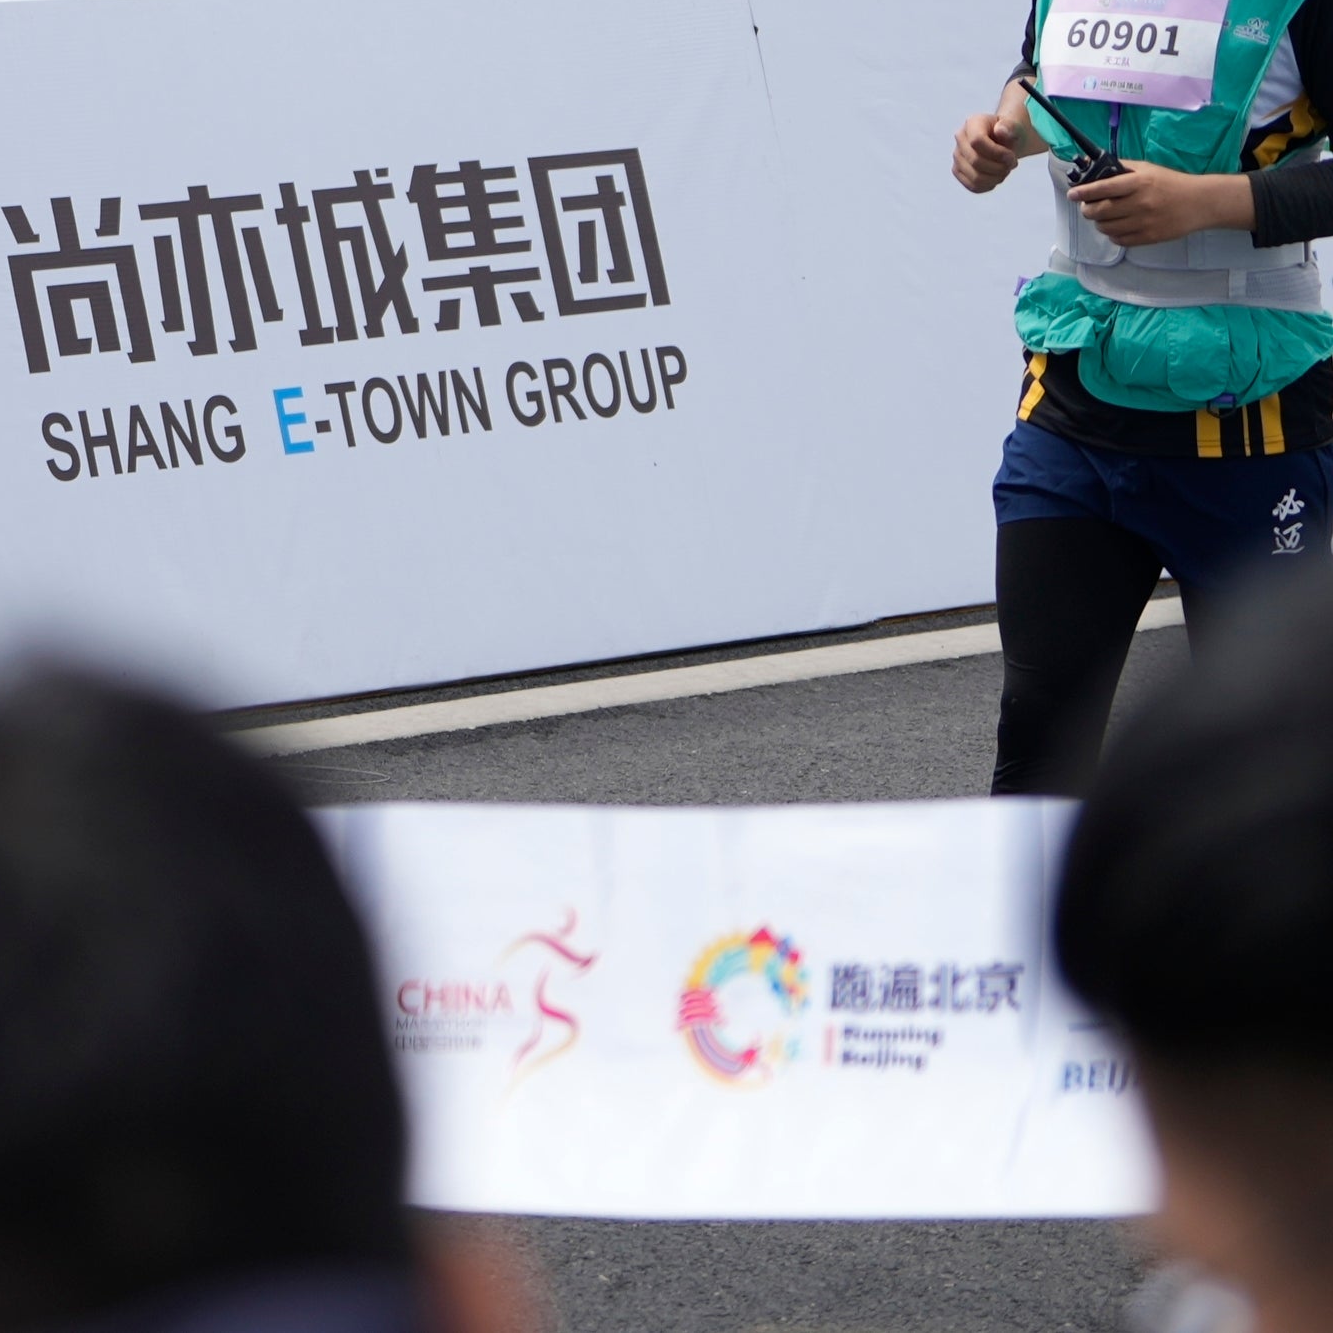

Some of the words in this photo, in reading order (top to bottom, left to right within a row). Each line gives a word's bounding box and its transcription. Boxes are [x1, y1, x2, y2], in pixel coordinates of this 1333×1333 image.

[1067, 18, 1181, 57] 60901
[1, 147, 672, 375] 尚亦城集团
[40, 394, 247, 483] SHANG
[272, 366, 493, 456] E-TOWN
[503, 344, 689, 428] GROUP
[396, 978, 514, 1017] CHINA
[831, 964, 1025, 1013] 跑遍北京
